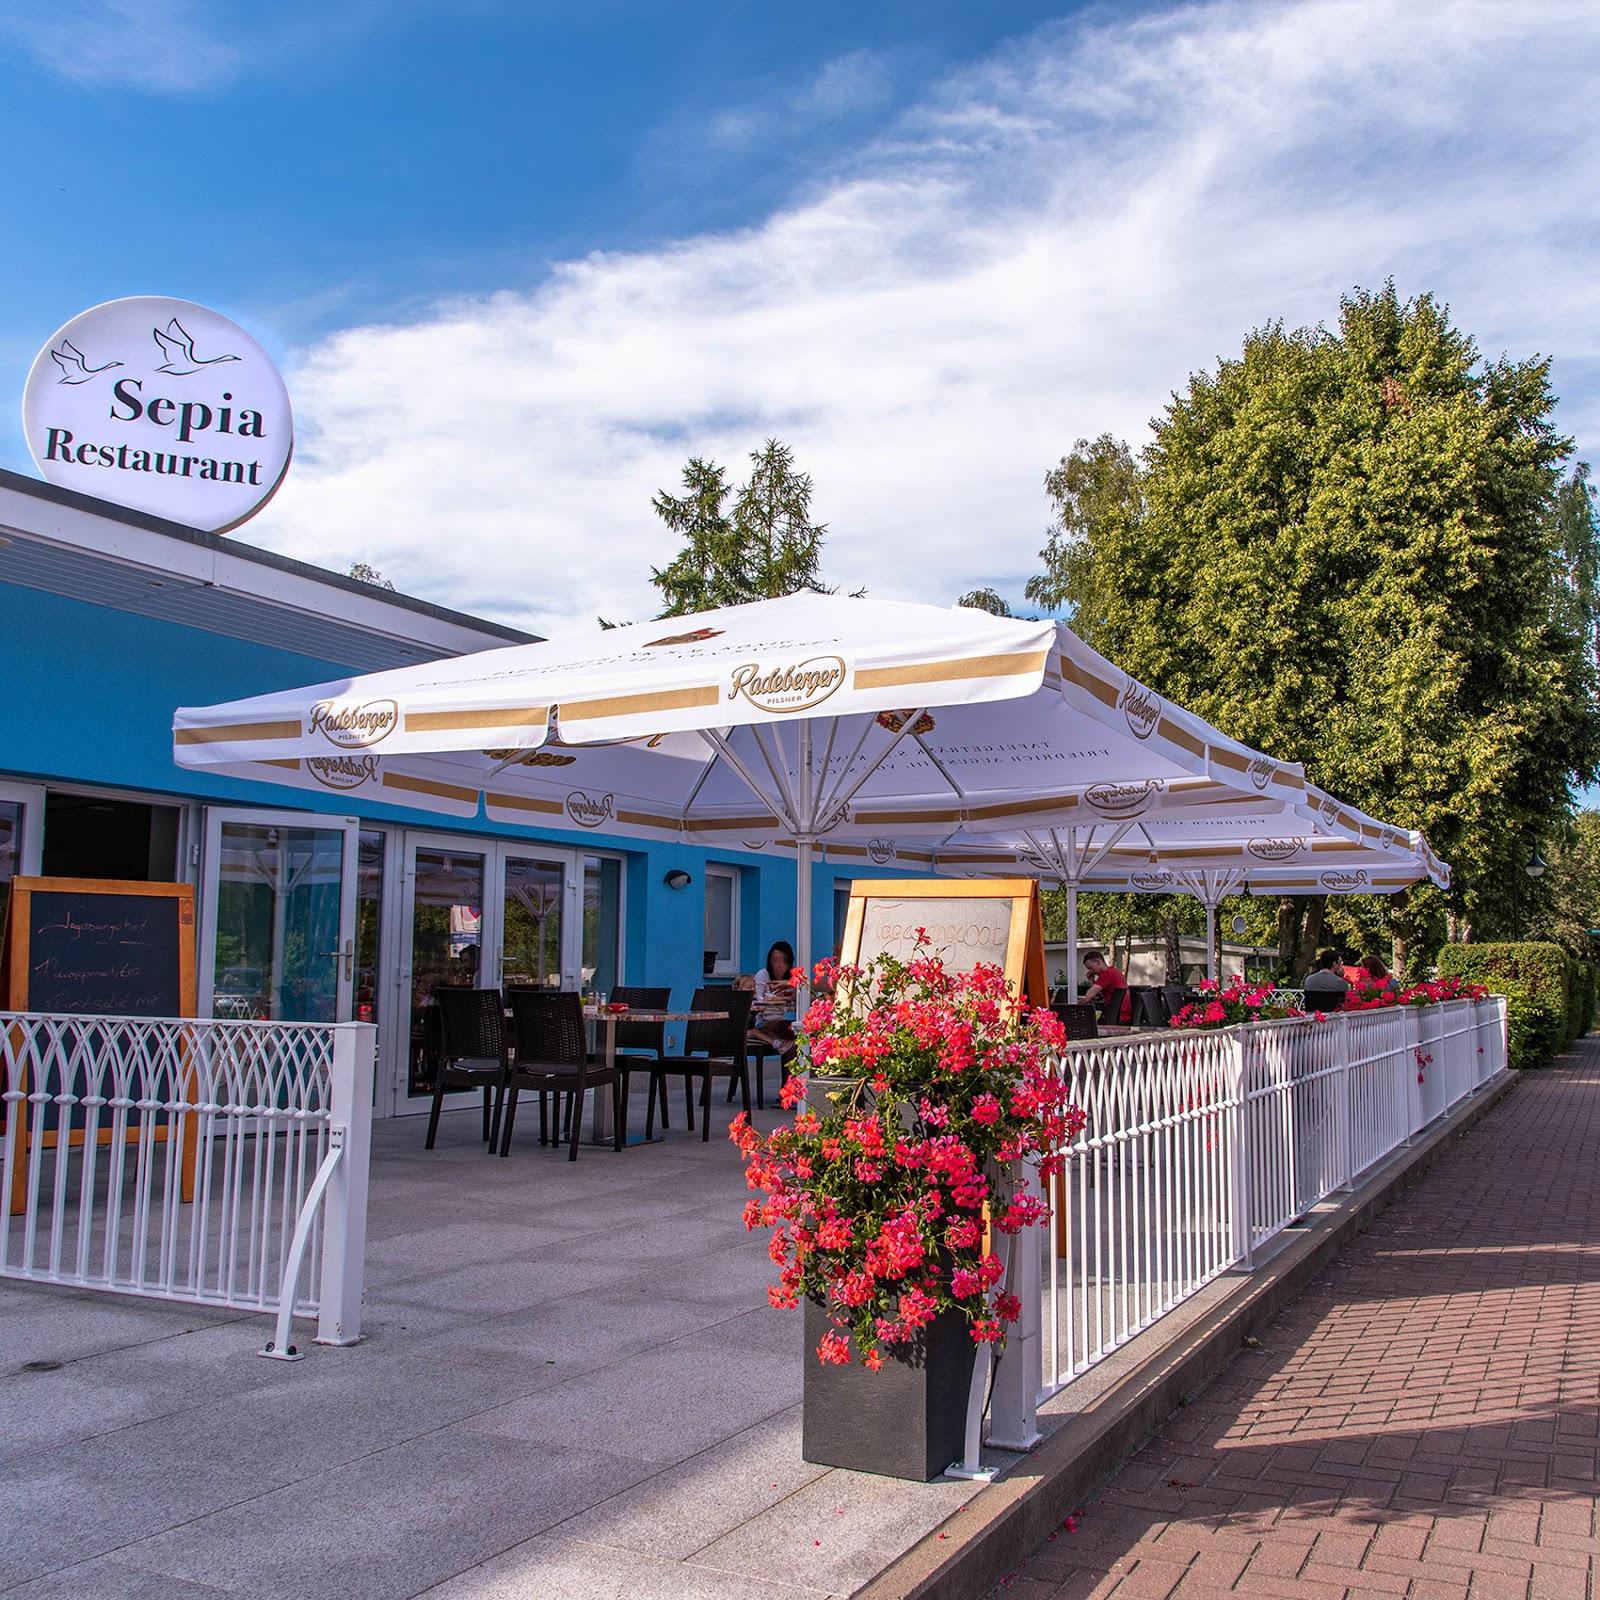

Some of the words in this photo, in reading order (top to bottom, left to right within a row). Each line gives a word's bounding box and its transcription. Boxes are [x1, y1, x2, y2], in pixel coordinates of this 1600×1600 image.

[110, 378, 266, 443] Sepia
[43, 427, 263, 486] Restaurant
[727, 659, 844, 706] Radeberger
[766, 695, 802, 704] PILSNER
[308, 700, 396, 742] Radeberger
